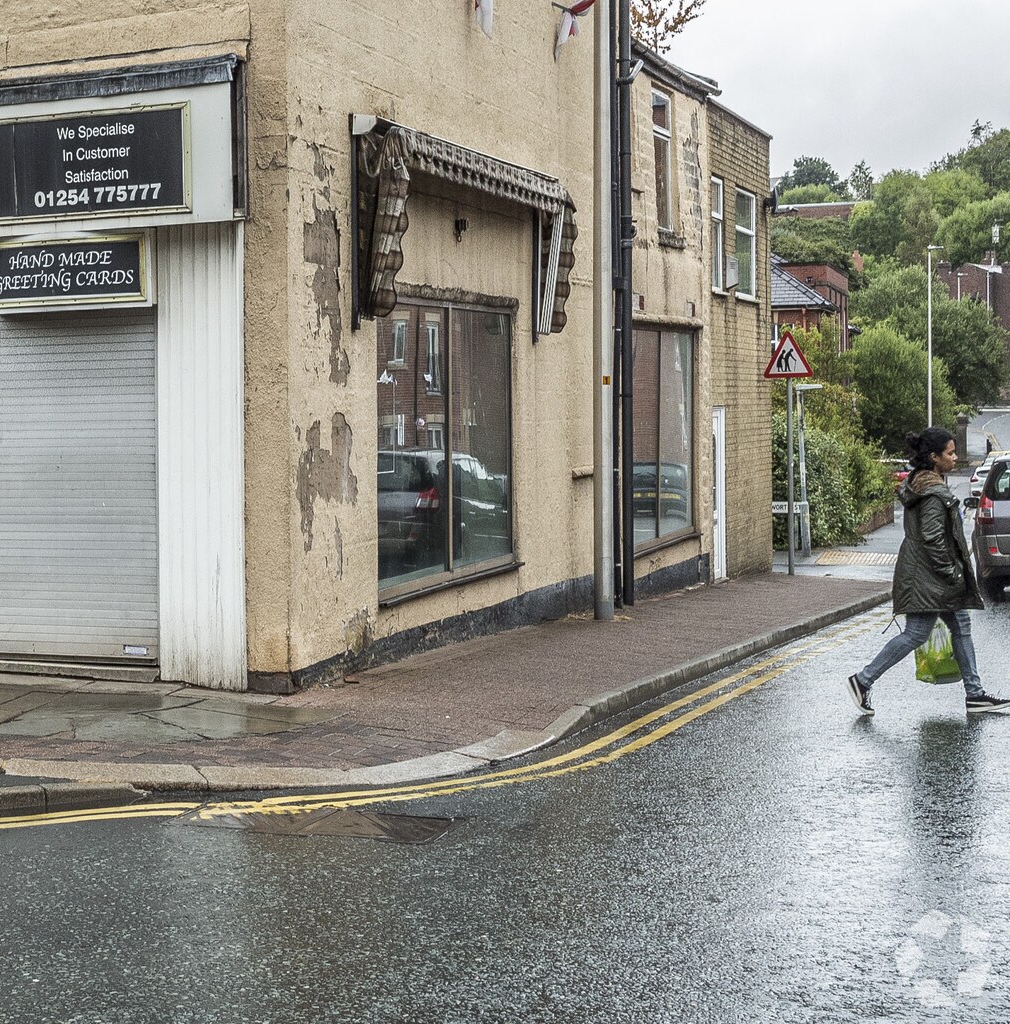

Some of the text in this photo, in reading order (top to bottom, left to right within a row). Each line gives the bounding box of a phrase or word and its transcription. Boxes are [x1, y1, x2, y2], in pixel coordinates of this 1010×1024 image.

[56, 122, 135, 141] We Specialise
[62, 146, 131, 162] In Customer
[65, 167, 129, 184] Satisfaction
[34, 182, 162, 208] 01254 775777
[9, 249, 113, 270] HAND MADE
[76, 269, 134, 286] CARDS
